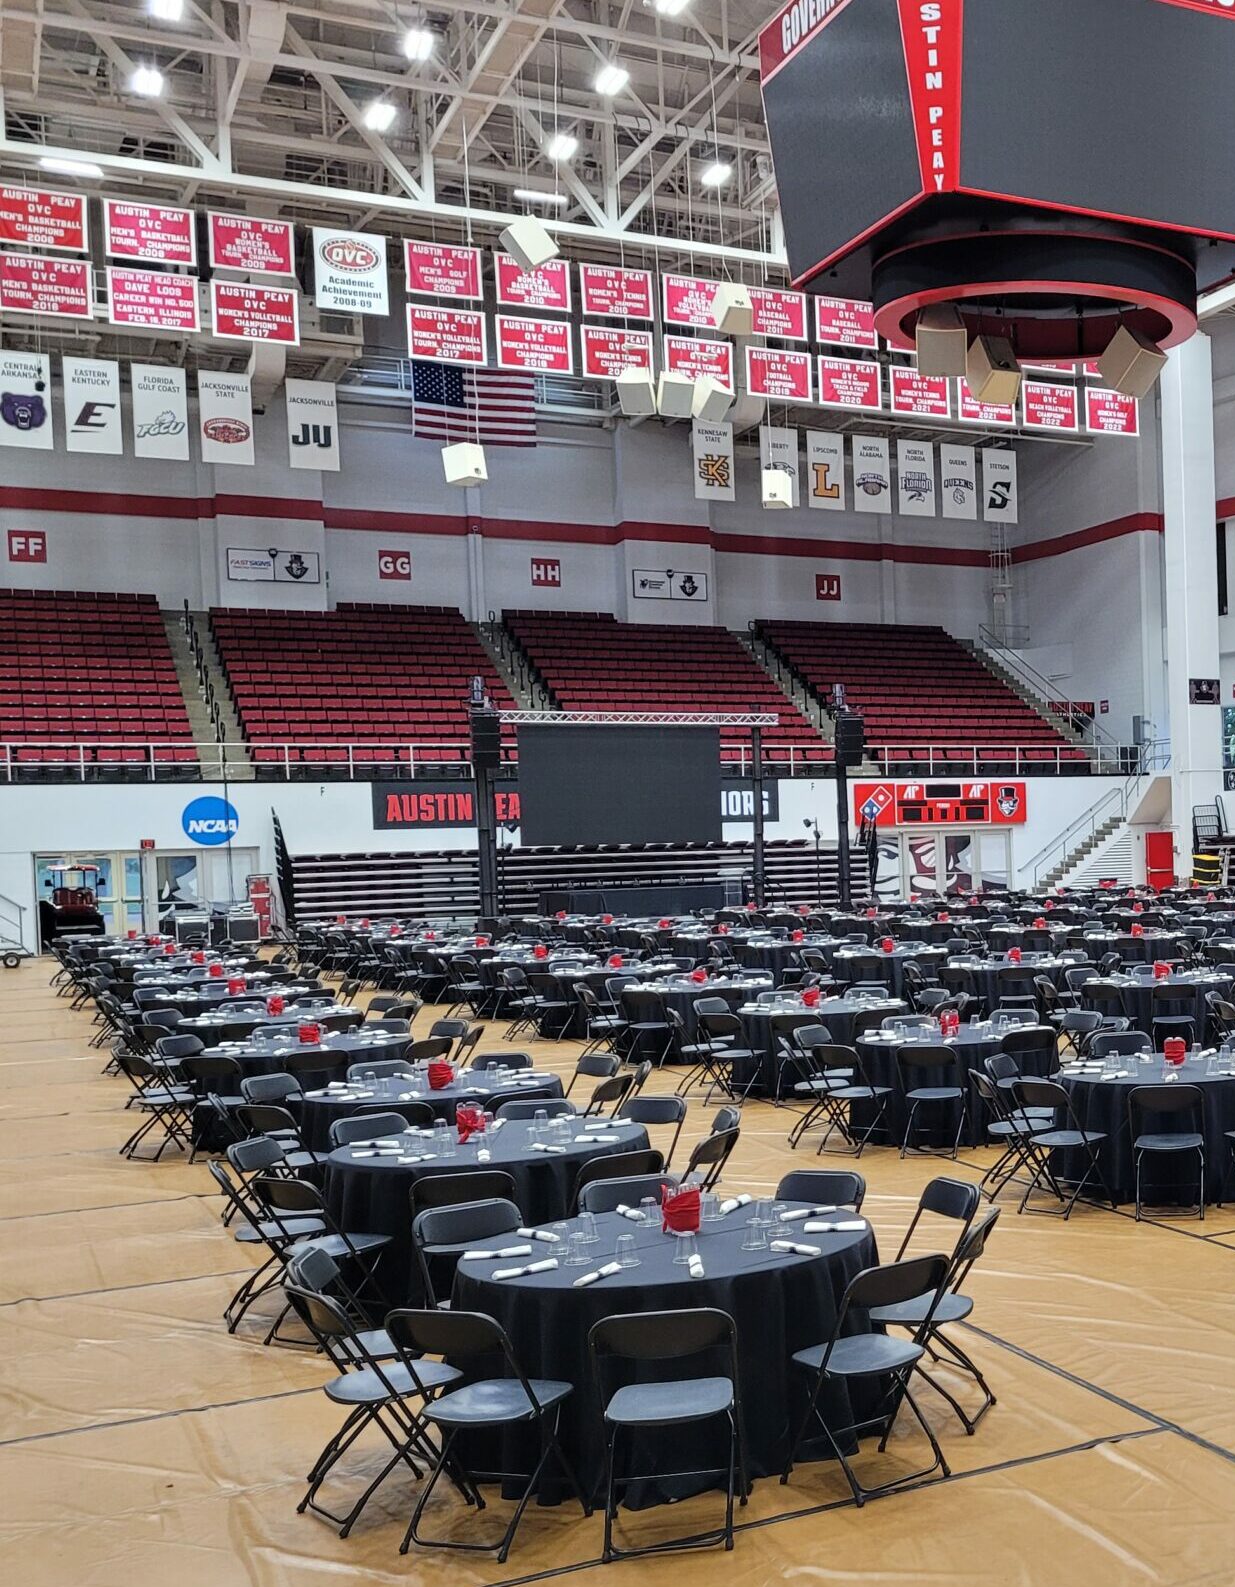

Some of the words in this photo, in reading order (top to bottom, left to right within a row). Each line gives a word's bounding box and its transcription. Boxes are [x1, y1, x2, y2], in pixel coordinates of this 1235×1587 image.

[929, 107, 944, 191] PEAY
[3, 189, 38, 202] AUSTIN
[51, 196, 75, 208] PEAY
[28, 204, 51, 214] OVC
[115, 206, 150, 217] AUSTIN
[160, 211, 184, 222] PEAY
[29, 216, 81, 229] BASKETBALL
[139, 219, 161, 229] OVC
[218, 218, 251, 229] AUSTIN
[261, 224, 285, 234] PEAY
[16, 223, 64, 236] CHAMPIONS
[141, 231, 189, 242] BASKETBALL
[241, 231, 262, 241] OVC
[147, 241, 190, 253] CHAMPIONS
[226, 244, 277, 257] BASKETBALL
[412, 245, 443, 256] AUSTIN
[452, 250, 473, 260] PEAY
[332, 248, 367, 265] OVC
[433, 258, 454, 267] OVC
[6, 257, 44, 270] AUSTIN
[54, 263, 81, 274] PEAY
[32, 271, 56, 282] OVC
[588, 268, 615, 278] AUSTIN
[624, 272, 644, 281] PEAY
[2, 279, 27, 289] MEN'S
[32, 283, 85, 296] BASKETBALL
[329, 276, 374, 288] Academic
[607, 280, 626, 289] OVC
[669, 278, 696, 289] AUSTIN
[125, 282, 150, 293] DAVE
[157, 286, 182, 296] LOOS
[220, 287, 256, 298] AUSTIN
[264, 292, 289, 302] PEAY
[322, 285, 382, 299] Achievement
[38, 294, 86, 305] CHAMPIONS
[114, 293, 146, 303] CAREER
[782, 295, 799, 303] PEAY
[245, 300, 266, 309] OVC
[766, 301, 782, 310] OVC
[821, 299, 846, 309] AUSTIN
[854, 304, 872, 313] PEAY
[117, 304, 154, 314] EASTERN
[160, 308, 192, 319] ILLINOIS
[218, 308, 248, 318] WOMEN'S
[251, 312, 292, 323] VOLLEYBALL
[415, 310, 448, 321] AUSTIN
[455, 314, 477, 325] PEAY
[234, 319, 278, 330] CHAMPIONS
[437, 322, 457, 331] OVC
[504, 321, 535, 331] AUSTIN
[542, 325, 564, 334] PEAY
[243, 328, 269, 337] 2017
[525, 332, 544, 342] OVC
[588, 331, 618, 341] AUSTIN
[625, 335, 645, 344] PEAY
[443, 334, 480, 344] VOLLEYBALL
[436, 349, 459, 358] 2017
[671, 341, 699, 351] AUSTIN
[706, 346, 726, 354] PEAY
[752, 352, 779, 361] AUSTIN
[785, 355, 804, 364] PEAY
[771, 363, 787, 371] OVC
[824, 361, 850, 371] AUSTIN
[856, 365, 874, 374] PEAY
[75, 369, 108, 378] EASTERN
[72, 377, 110, 386] KENTUCKY
[144, 376, 173, 384] FLORIDA
[138, 383, 156, 391] GULF
[158, 386, 180, 394] COAST
[201, 382, 248, 392] JACKSONVILLE
[289, 397, 335, 407] JACKSONVILLE
[698, 429, 727, 437] KENNESAW
[813, 447, 837, 455] LIPSCOMB
[812, 462, 839, 498] L
[944, 478, 973, 490] QUEENS
[12, 536, 44, 556] FF
[379, 556, 411, 574] GG
[531, 564, 560, 582] HH
[819, 579, 838, 595] JJ
[386, 793, 472, 822] AUSTIN
[188, 819, 238, 833] NCAA
